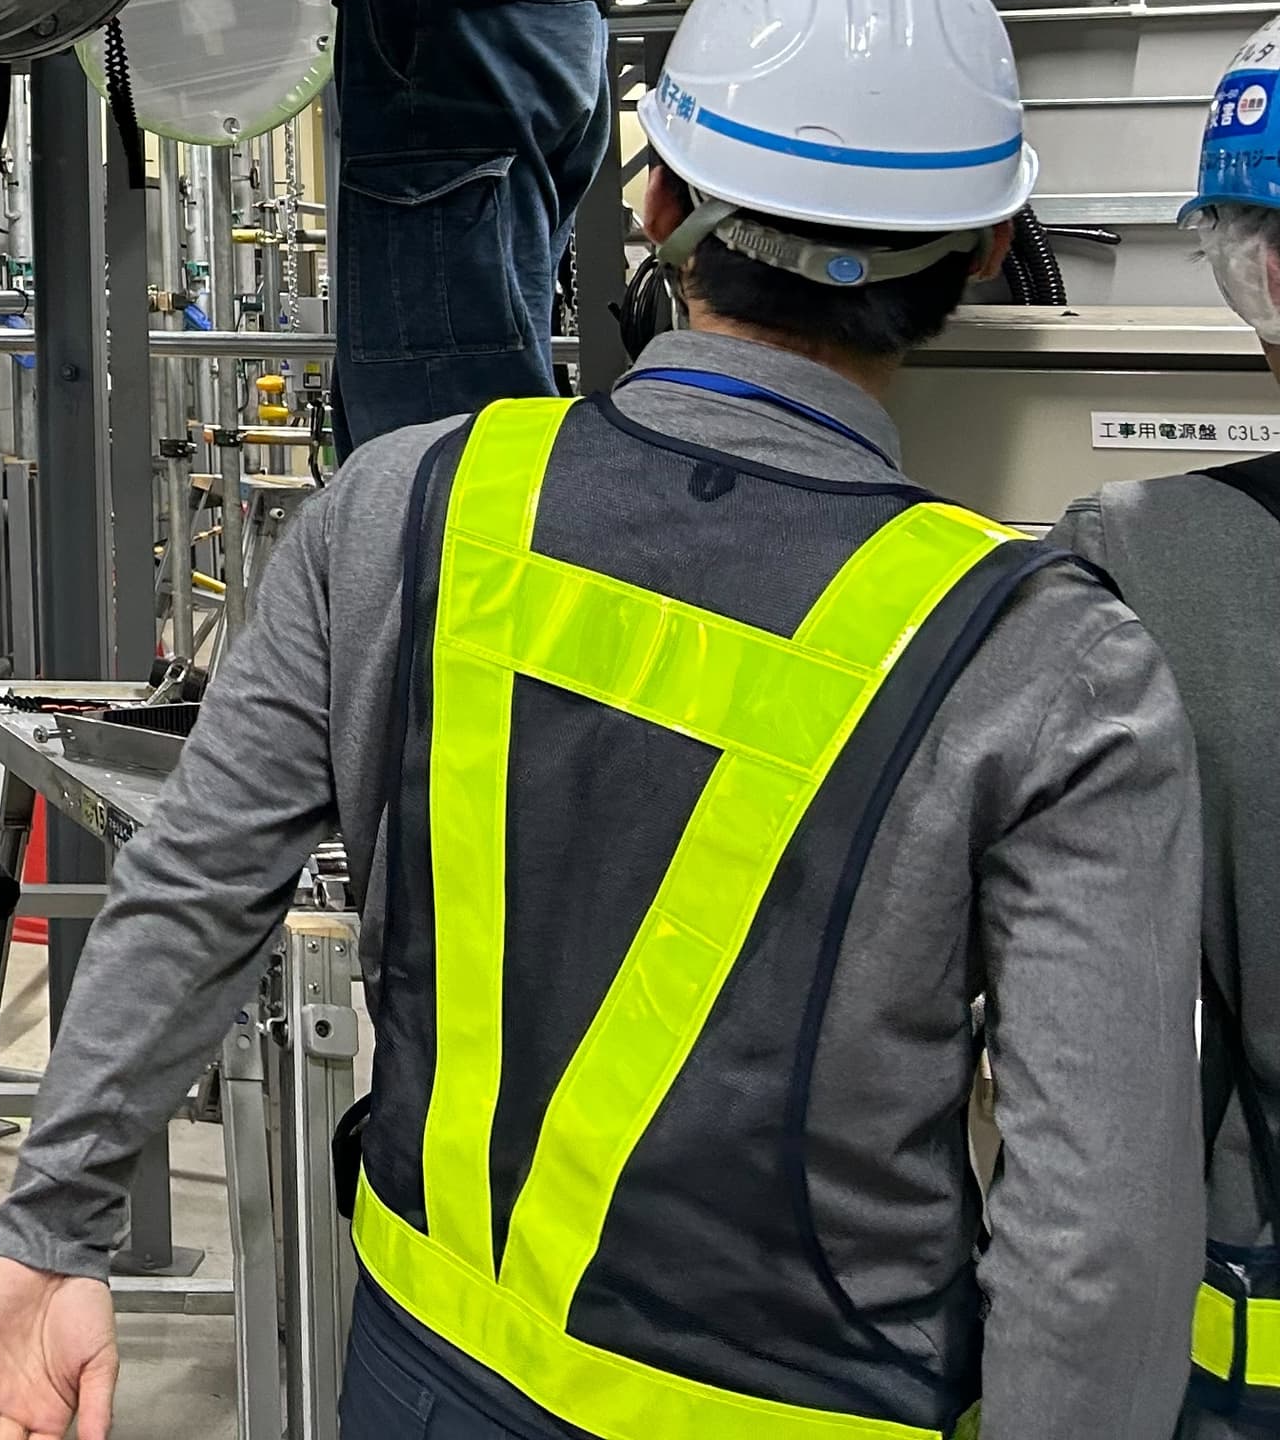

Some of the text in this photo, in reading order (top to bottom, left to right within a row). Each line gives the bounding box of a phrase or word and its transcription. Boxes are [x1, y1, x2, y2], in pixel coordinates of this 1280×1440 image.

[1099, 422, 1217, 440] 工事用電源盤
